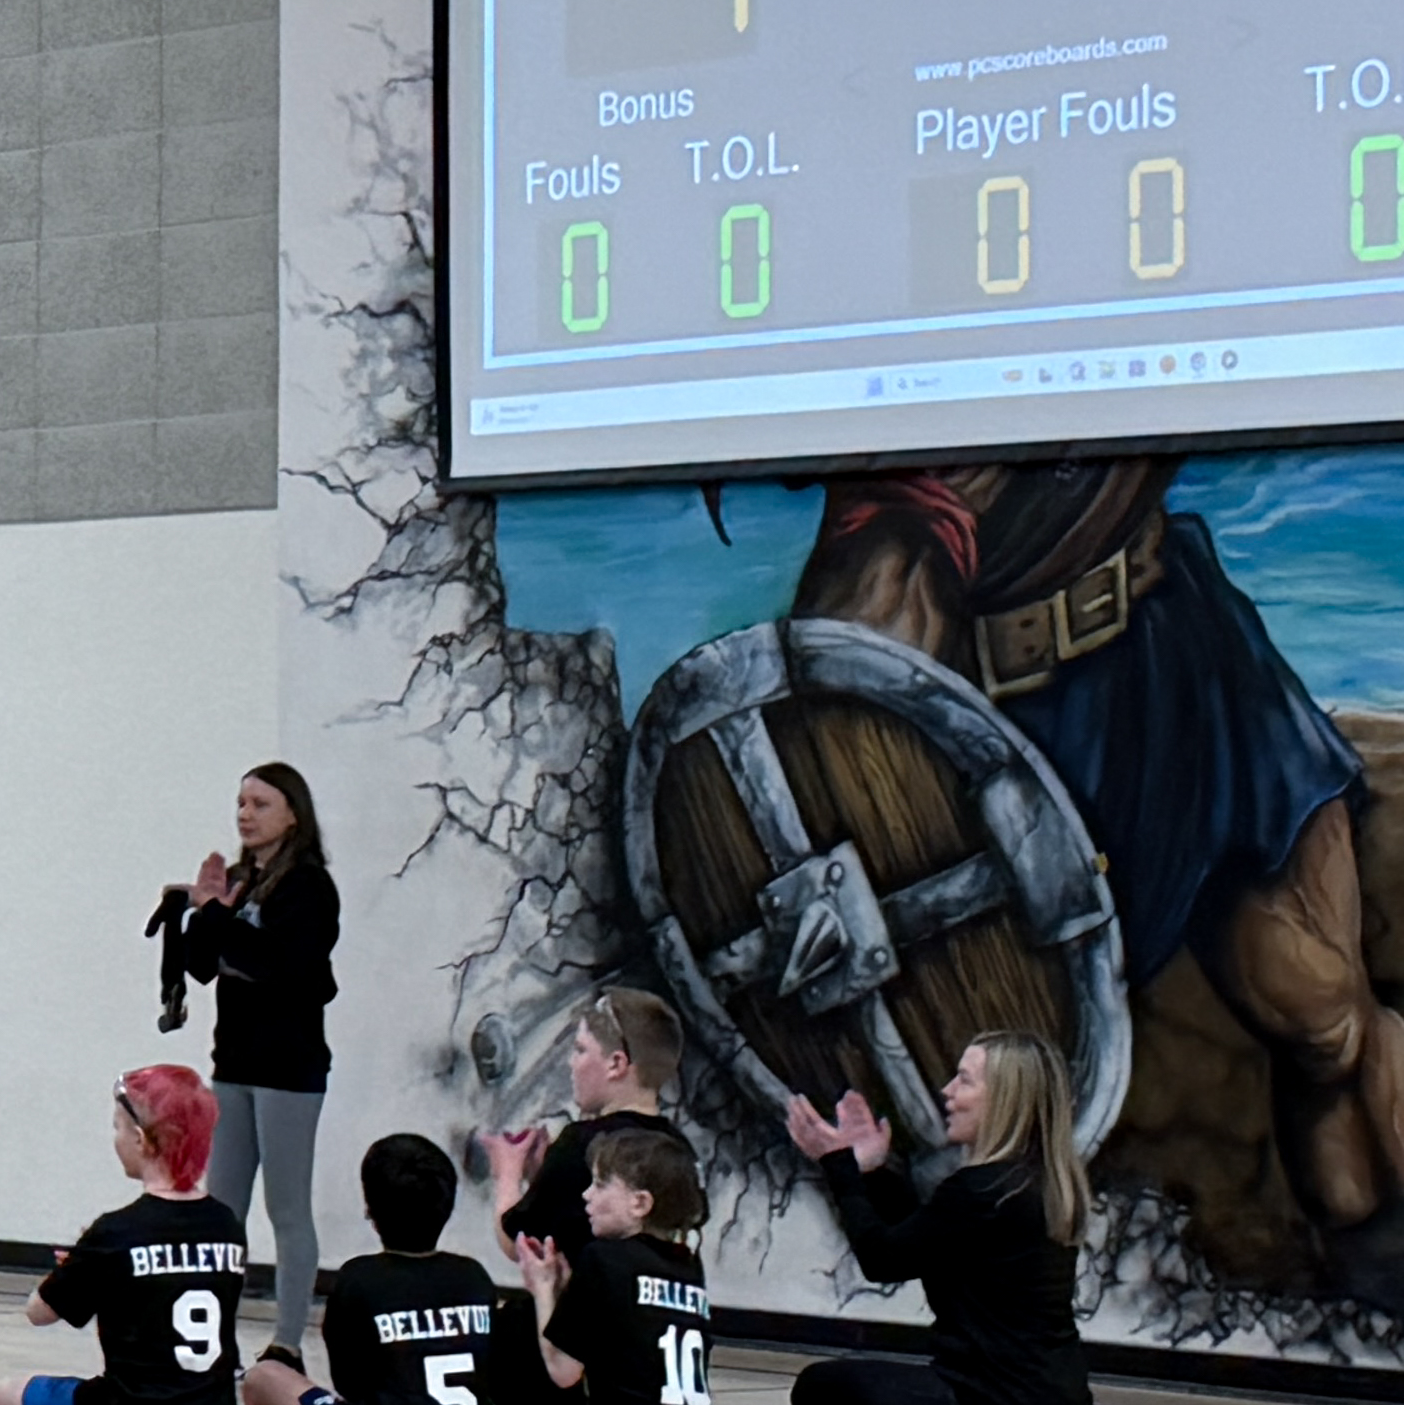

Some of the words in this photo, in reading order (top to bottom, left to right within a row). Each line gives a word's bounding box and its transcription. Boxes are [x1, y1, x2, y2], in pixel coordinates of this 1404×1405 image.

[914, 33, 1168, 81] www.pcscoreboards.com
[598, 88, 694, 127] Bonus
[916, 105, 1046, 159] Player
[1059, 82, 1177, 138] Fouls
[525, 154, 622, 204] Fouls
[684, 131, 801, 184] T.O.L.
[1128, 156, 1184, 280] 0
[1350, 133, 1404, 262] 0
[720, 202, 771, 319] 0
[977, 175, 1030, 294] 0
[561, 220, 609, 334] 0
[130, 1242, 246, 1278] BELLEVU
[373, 1304, 491, 1344] BELLEVU
[637, 1275, 711, 1321] BELLEV
[172, 1290, 222, 1373] 9
